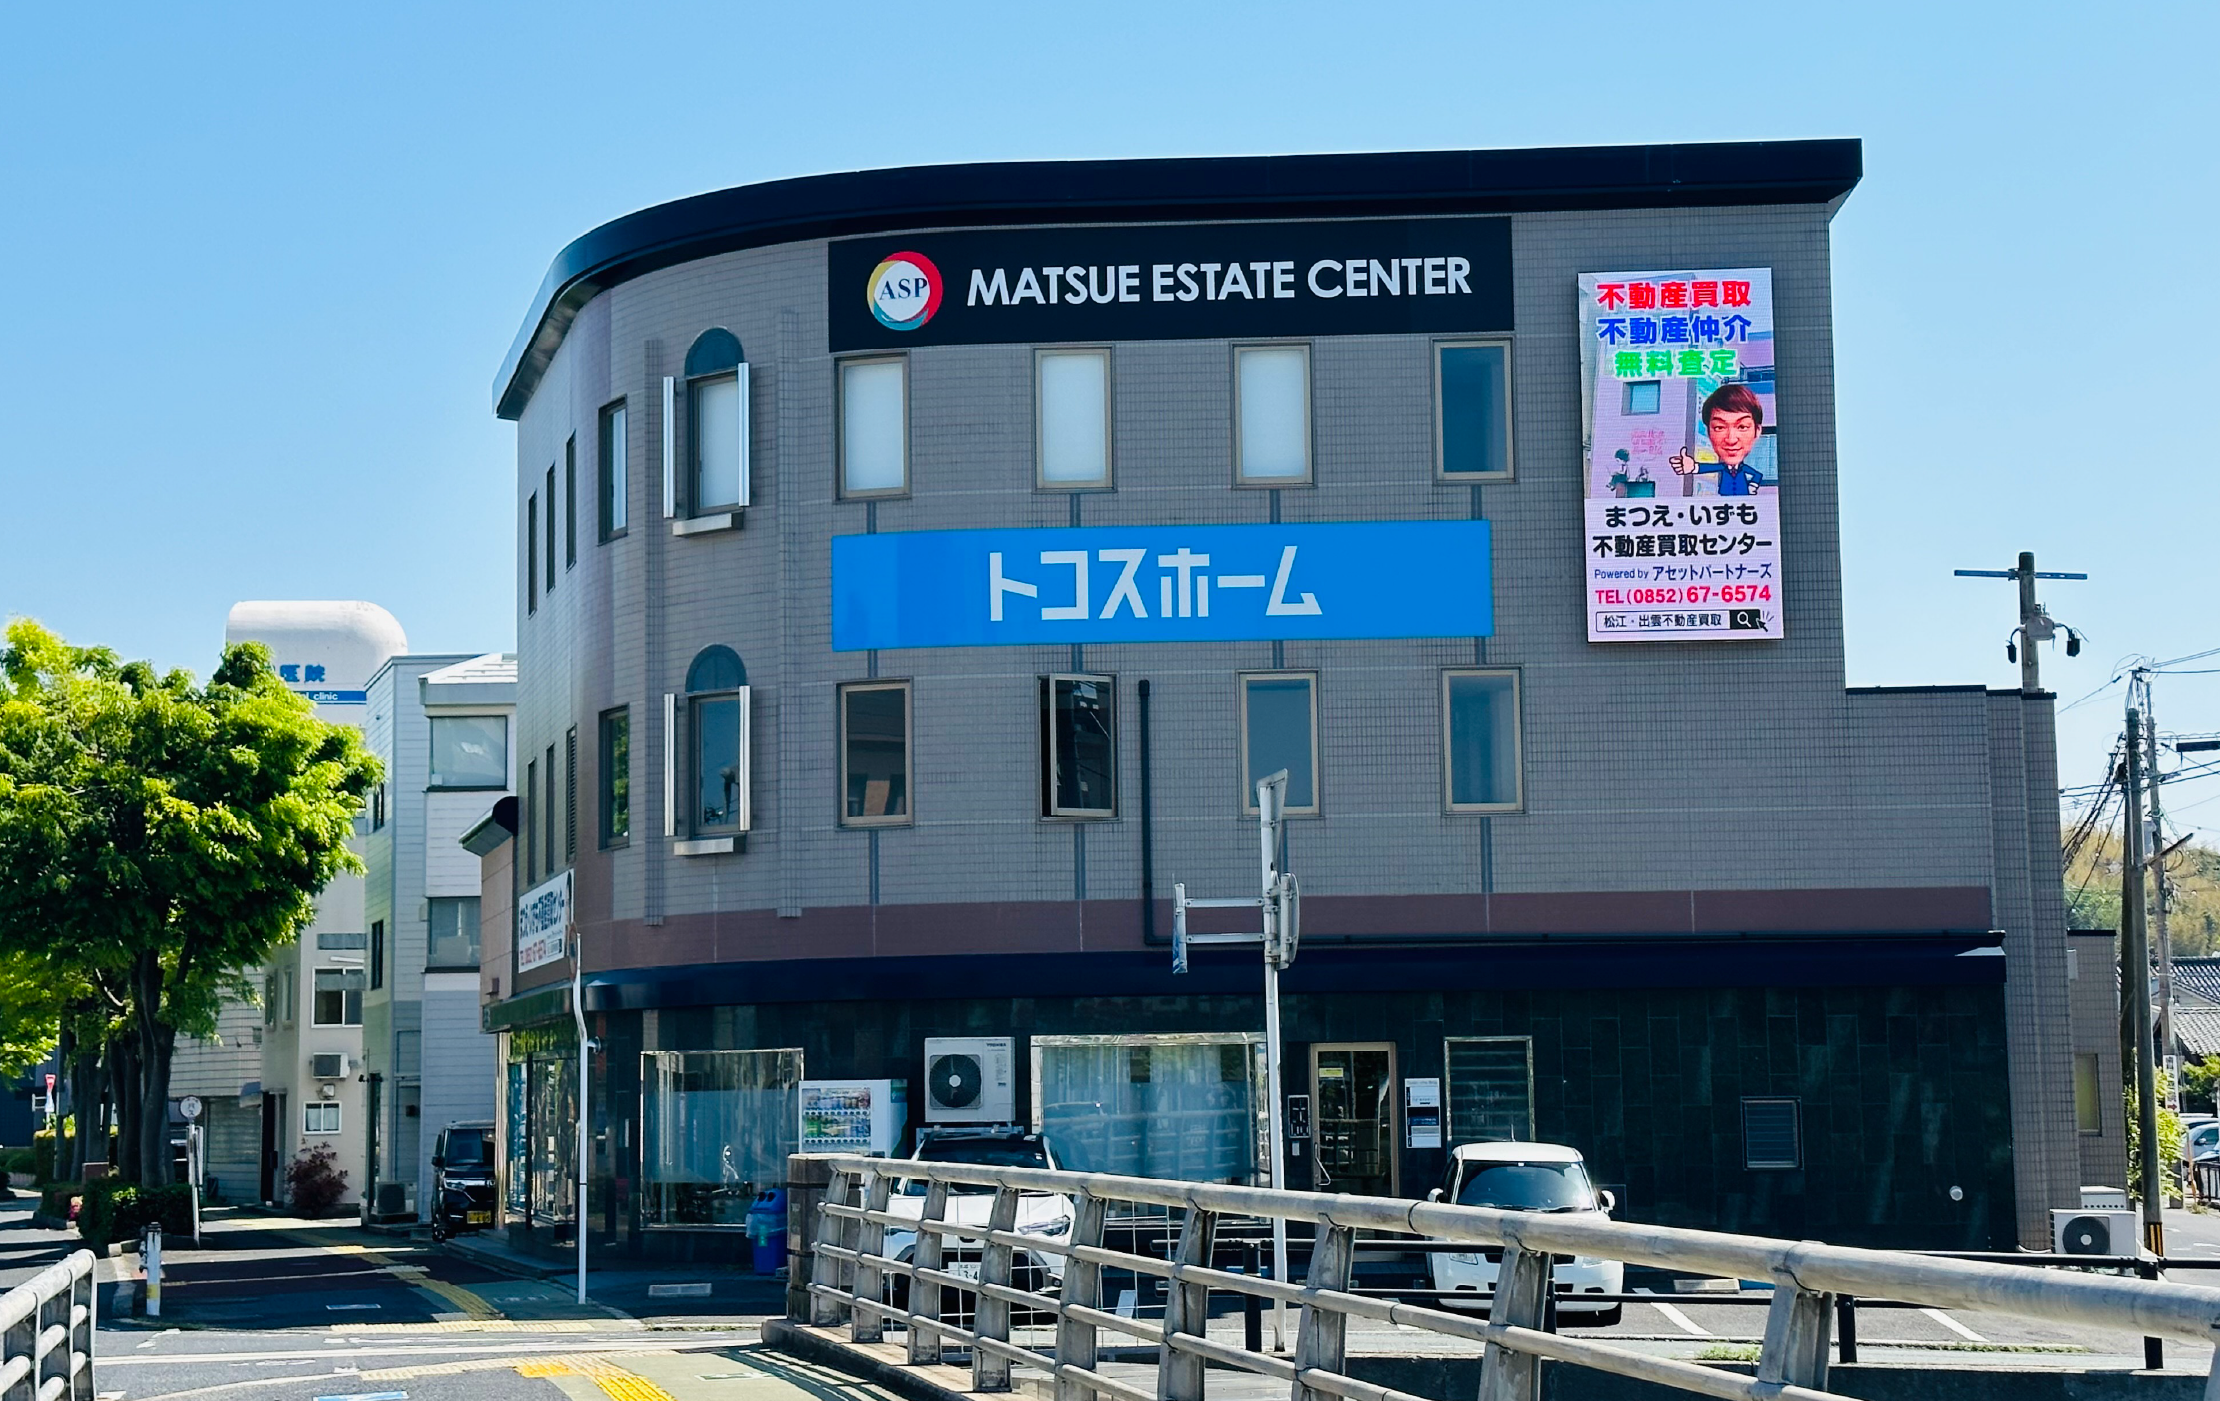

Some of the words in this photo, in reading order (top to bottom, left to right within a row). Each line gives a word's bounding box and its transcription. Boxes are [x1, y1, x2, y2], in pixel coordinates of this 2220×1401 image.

[879, 278, 928, 300] ASP
[967, 265, 1140, 306] MATSUE
[1152, 261, 1295, 302] ESTATE
[1307, 256, 1473, 299] CENTER
[1597, 281, 1751, 311] 不動産買取
[1598, 314, 1752, 345] 不動産仲介
[1614, 350, 1738, 378] 無料査定
[1605, 503, 1759, 528] まつえ・いずも
[1592, 532, 1773, 558] 不動産買取センター
[989, 545, 1323, 622] トコスホーム
[1594, 568, 1635, 579] Powered
[1637, 567, 1649, 579] by
[1652, 562, 1772, 581] アセットパートナーズ
[1595, 585, 1772, 605] TEL(0852)67-6574
[1603, 613, 1722, 629] 松江・出雲不動産買取
[268, 664, 326, 683] 医院
[313, 690, 339, 701] clinic
